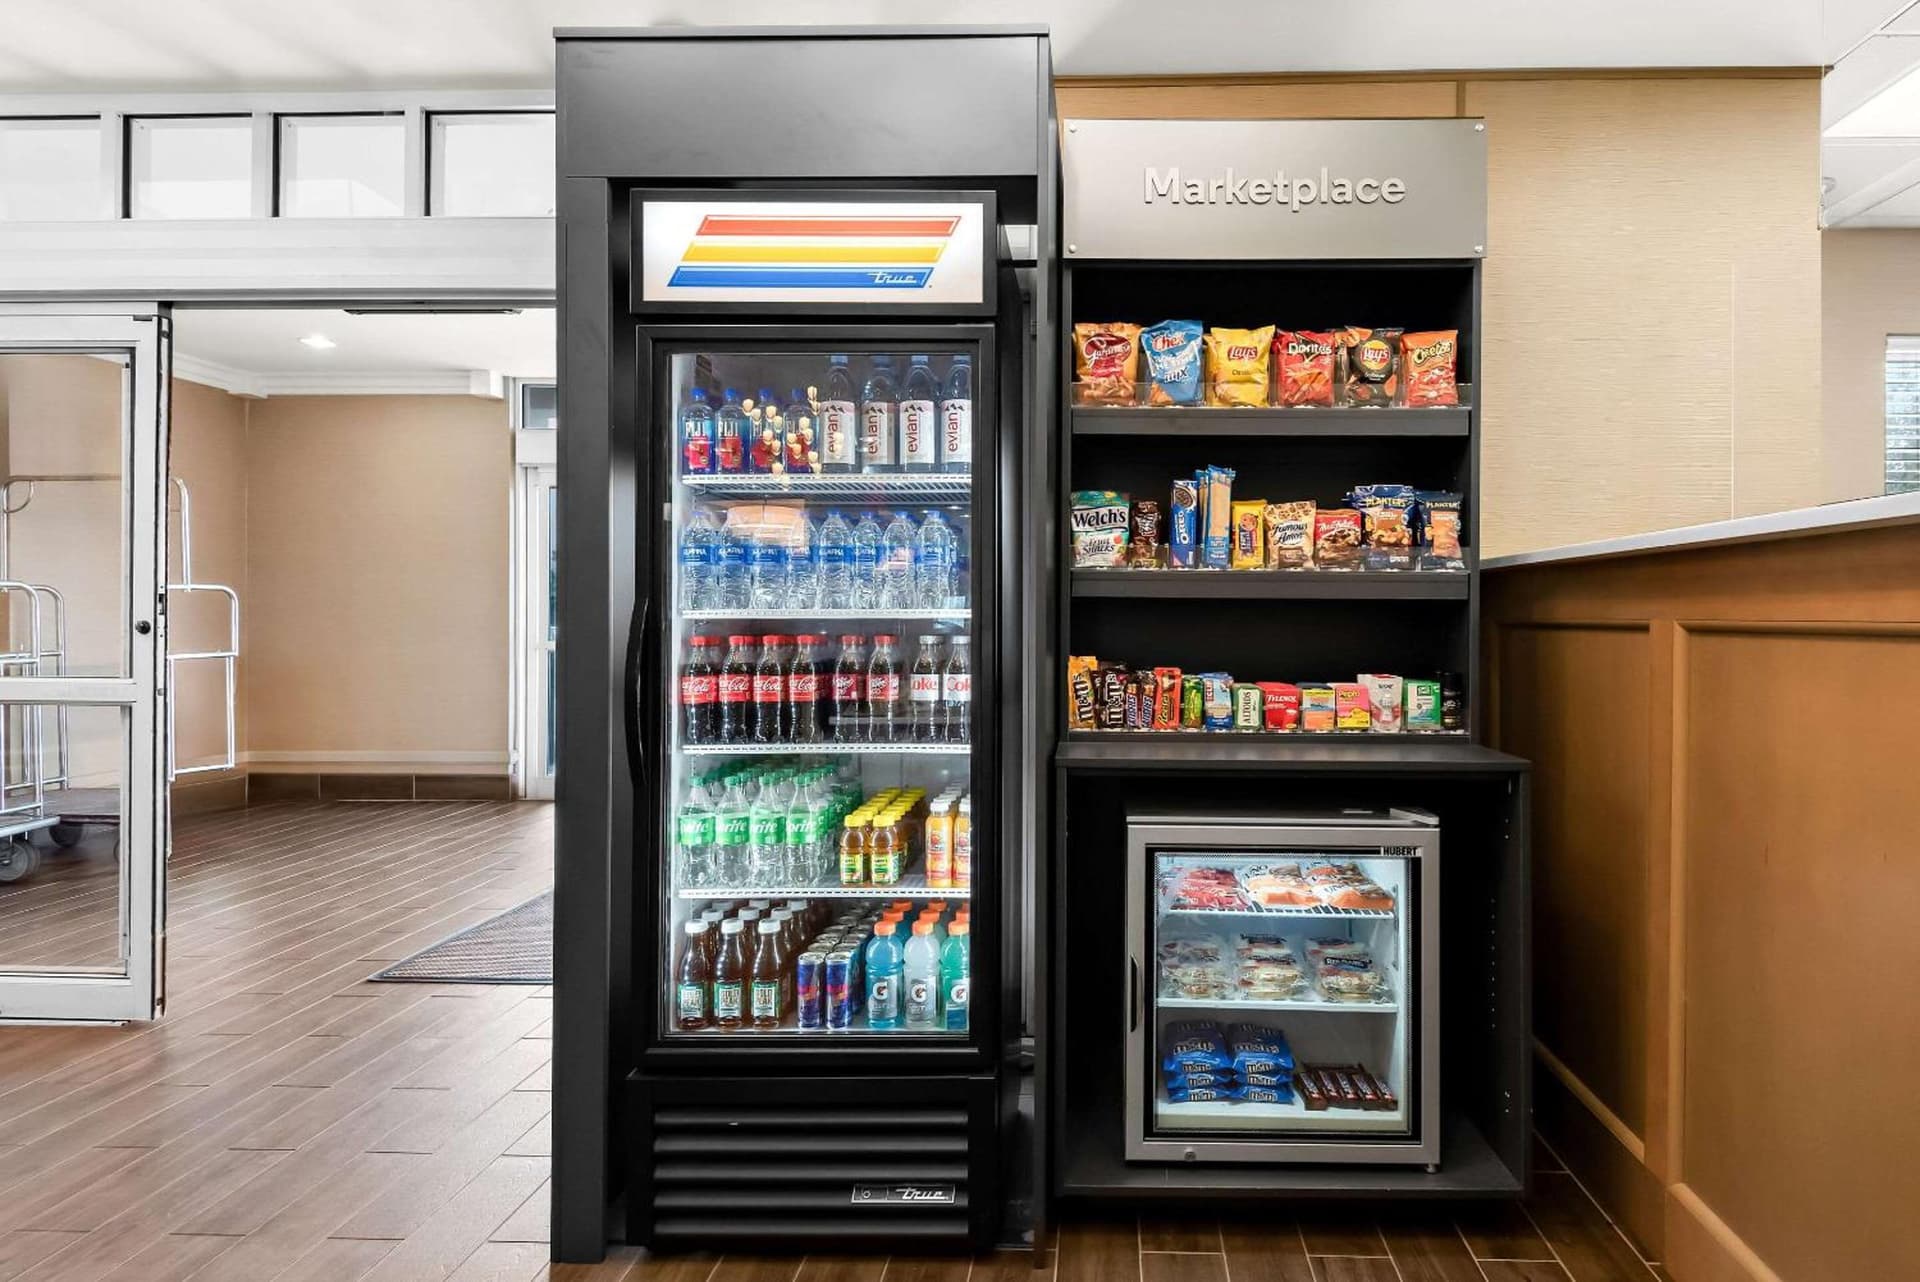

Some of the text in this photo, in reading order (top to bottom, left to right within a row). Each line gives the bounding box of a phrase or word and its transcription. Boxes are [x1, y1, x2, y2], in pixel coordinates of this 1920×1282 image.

[1144, 166, 1406, 213] Marketplace
[1288, 342, 1332, 355] Doritos
[868, 415, 878, 455] evian
[906, 413, 918, 453] evian
[946, 412, 958, 452] evian
[1071, 508, 1126, 527] Welch's
[912, 676, 938, 691] oke
[1384, 846, 1417, 856] HUBERT
[896, 1187, 949, 1200] True
